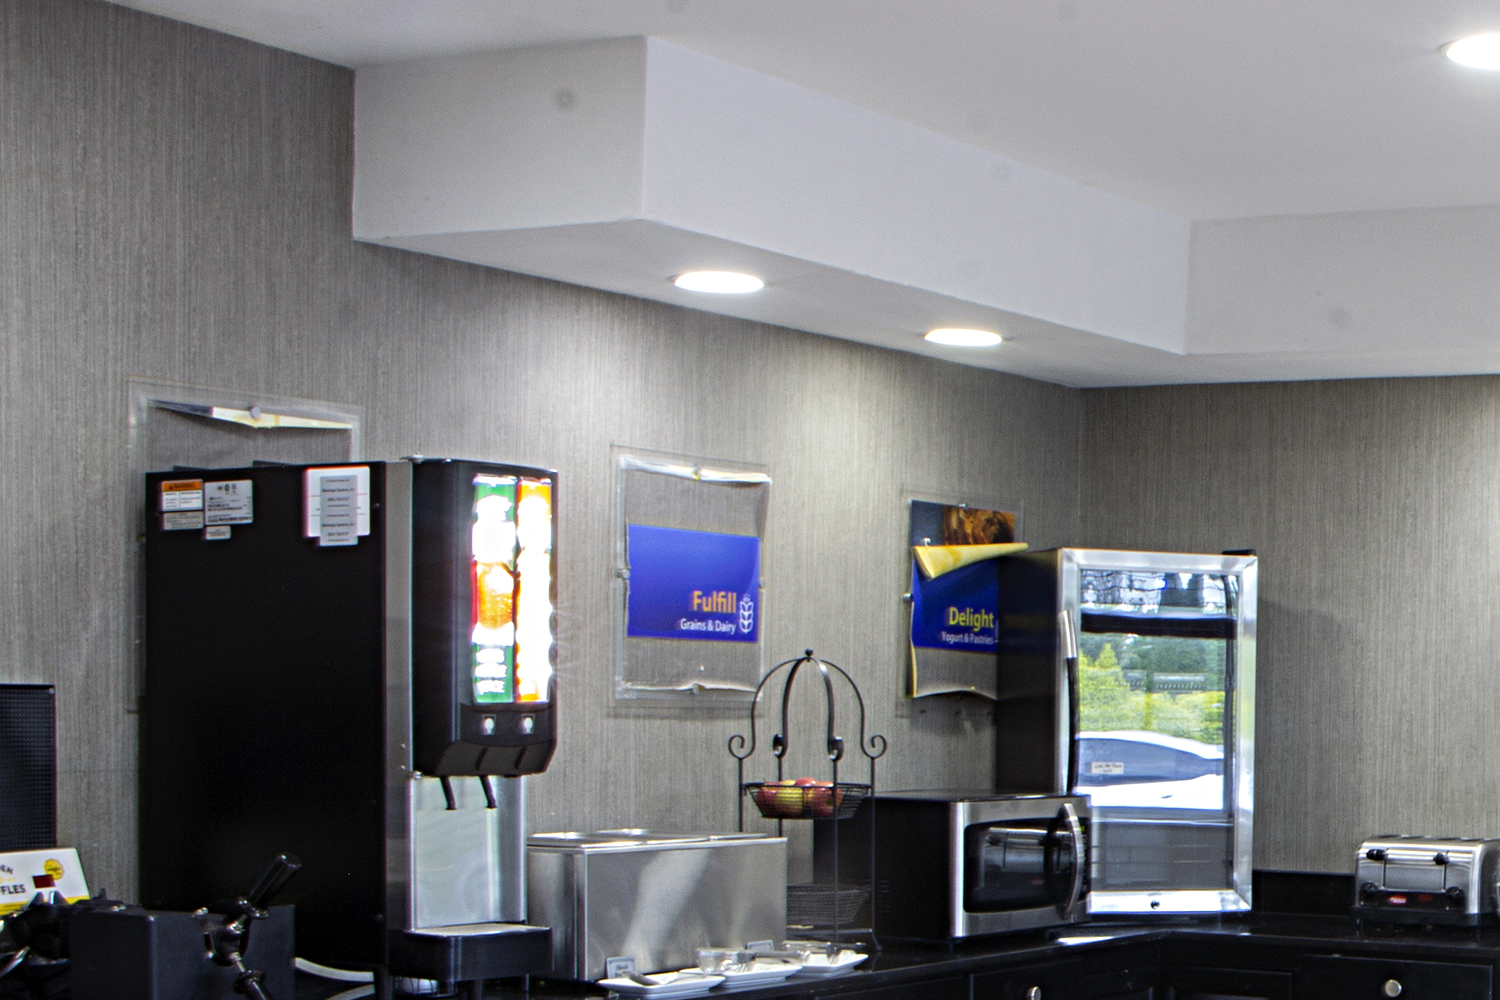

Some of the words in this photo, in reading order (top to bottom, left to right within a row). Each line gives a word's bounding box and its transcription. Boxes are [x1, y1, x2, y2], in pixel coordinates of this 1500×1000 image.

[693, 590, 737, 613] Fulfill
[680, 618, 706, 631] Grains
[707, 619, 714, 631] &
[715, 620, 736, 635] Dairy
[949, 606, 994, 632] Delight
[941, 631, 963, 644] Yogurt
[964, 633, 969, 643] &
[970, 633, 994, 645] Pastries
[0, 864, 13, 874] EN
[0, 884, 26, 895] FLES
